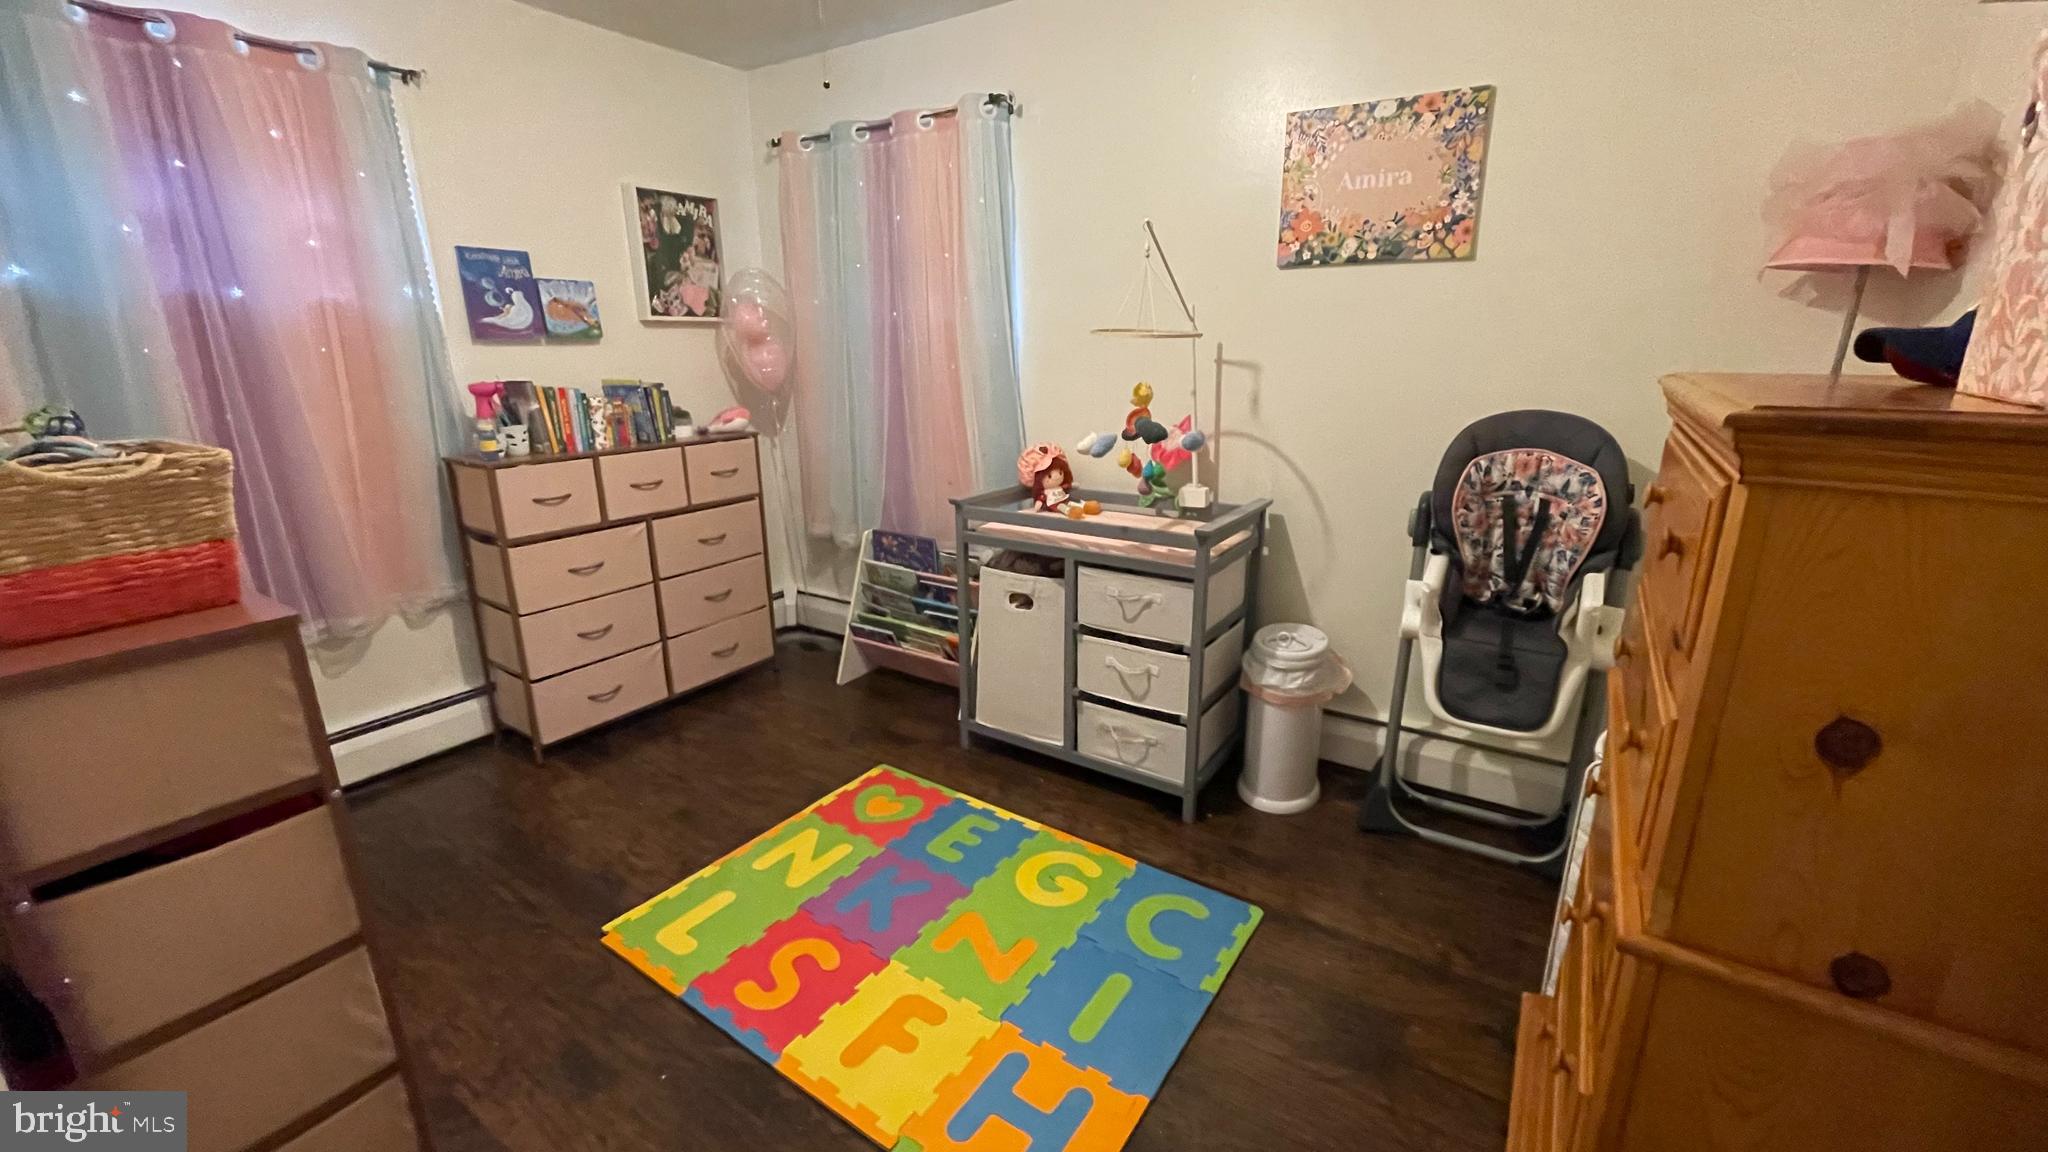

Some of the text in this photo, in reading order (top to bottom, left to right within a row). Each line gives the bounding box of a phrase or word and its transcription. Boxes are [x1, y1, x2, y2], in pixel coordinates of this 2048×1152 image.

[1337, 169, 1412, 191] Amira
[676, 199, 713, 229] AMIRA
[752, 831, 853, 888] N
[926, 814, 1000, 862] E
[836, 864, 931, 932] K
[1015, 850, 1103, 907] G
[656, 890, 736, 955] L
[1127, 893, 1209, 961] C
[733, 937, 840, 1010] S
[839, 994, 947, 1068] F
[946, 1052, 1095, 1152] H
